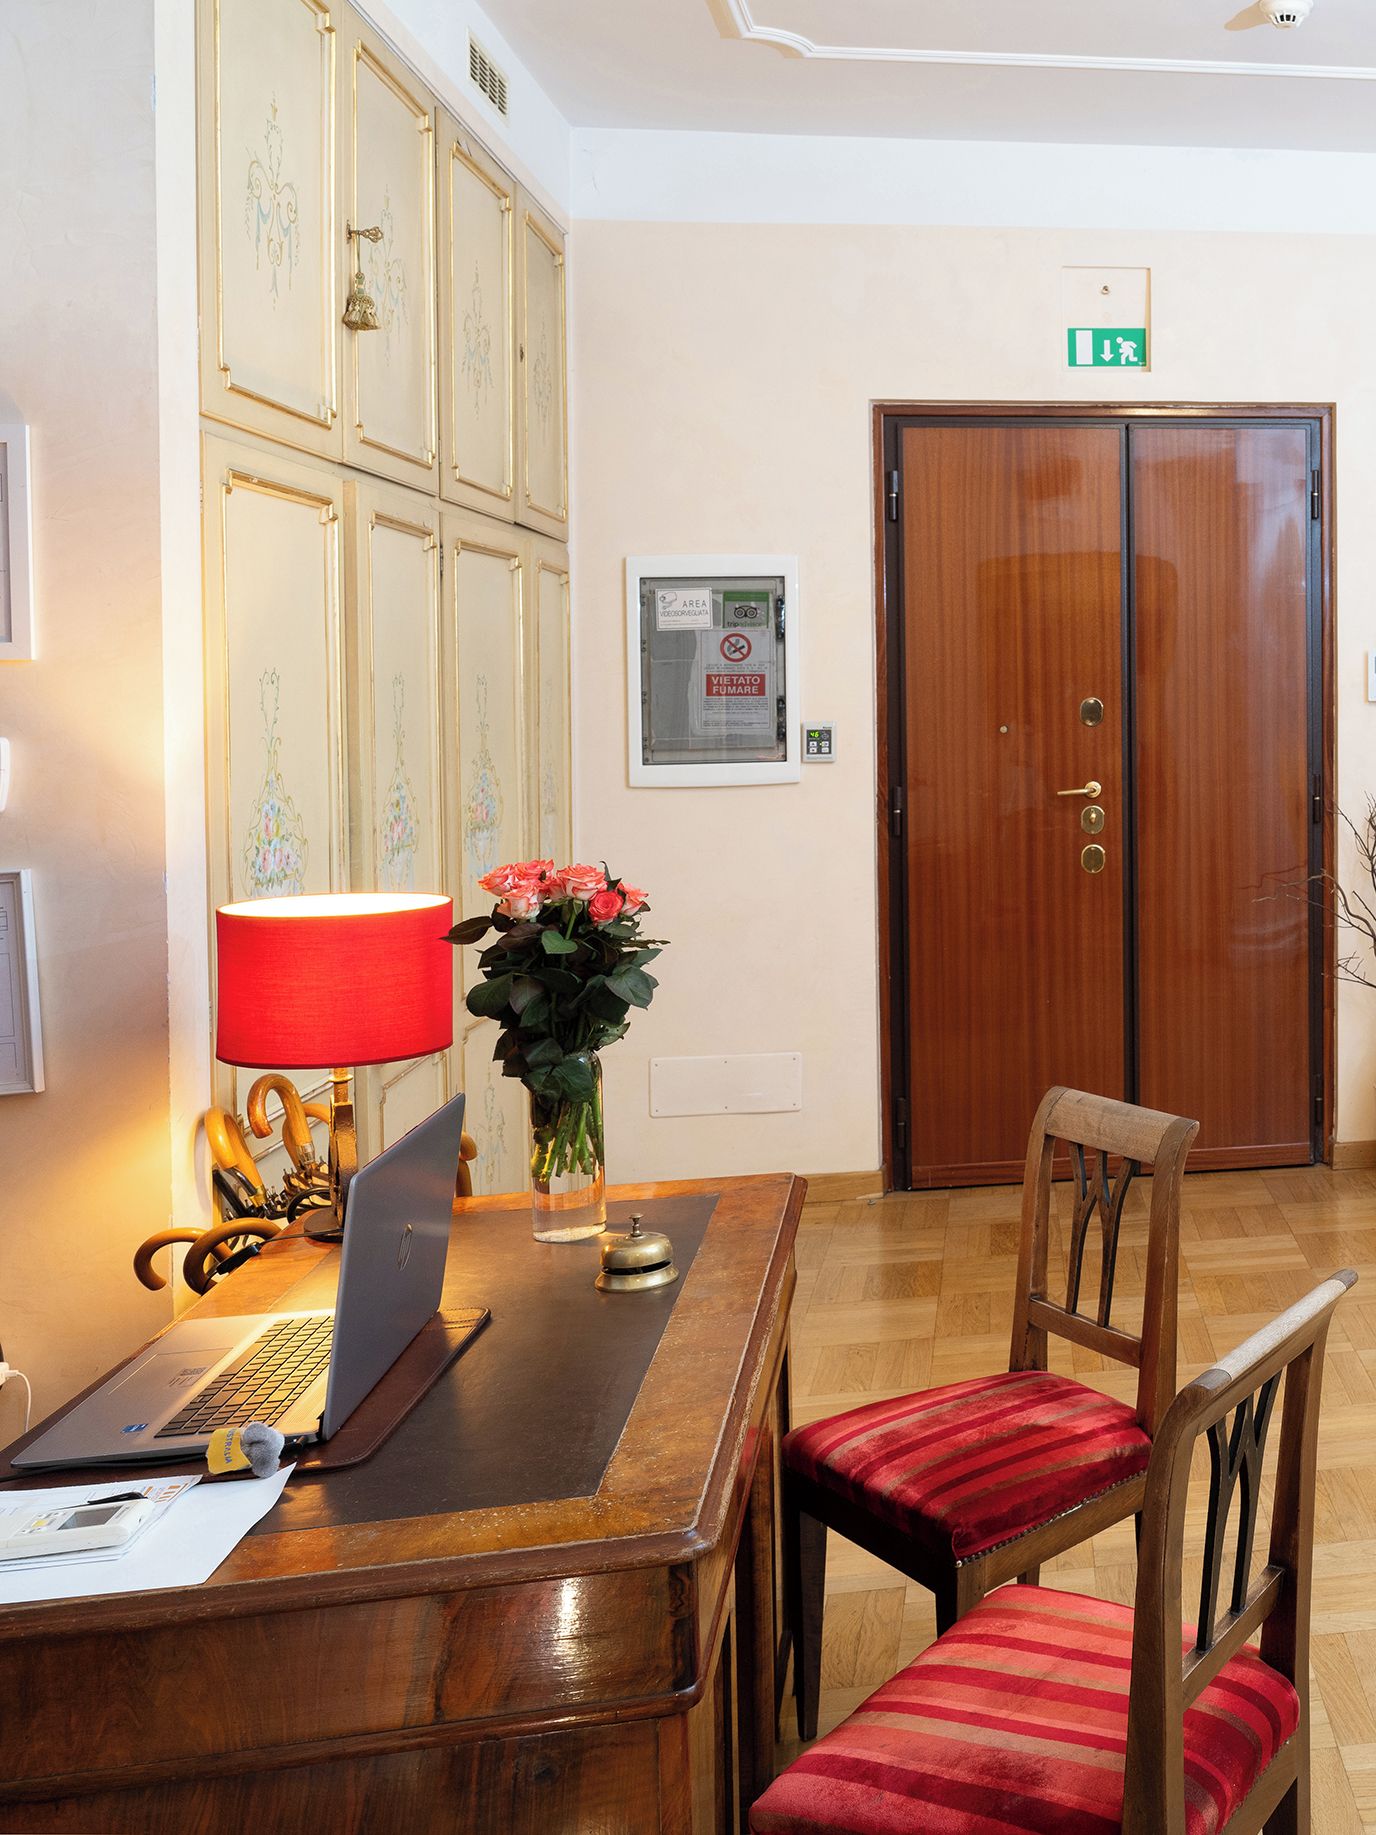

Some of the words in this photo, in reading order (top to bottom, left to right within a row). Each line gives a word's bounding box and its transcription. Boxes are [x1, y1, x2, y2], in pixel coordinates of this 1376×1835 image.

[681, 600, 708, 608] AREA
[711, 676, 760, 685] VIETATO
[712, 686, 759, 694] FUMARE
